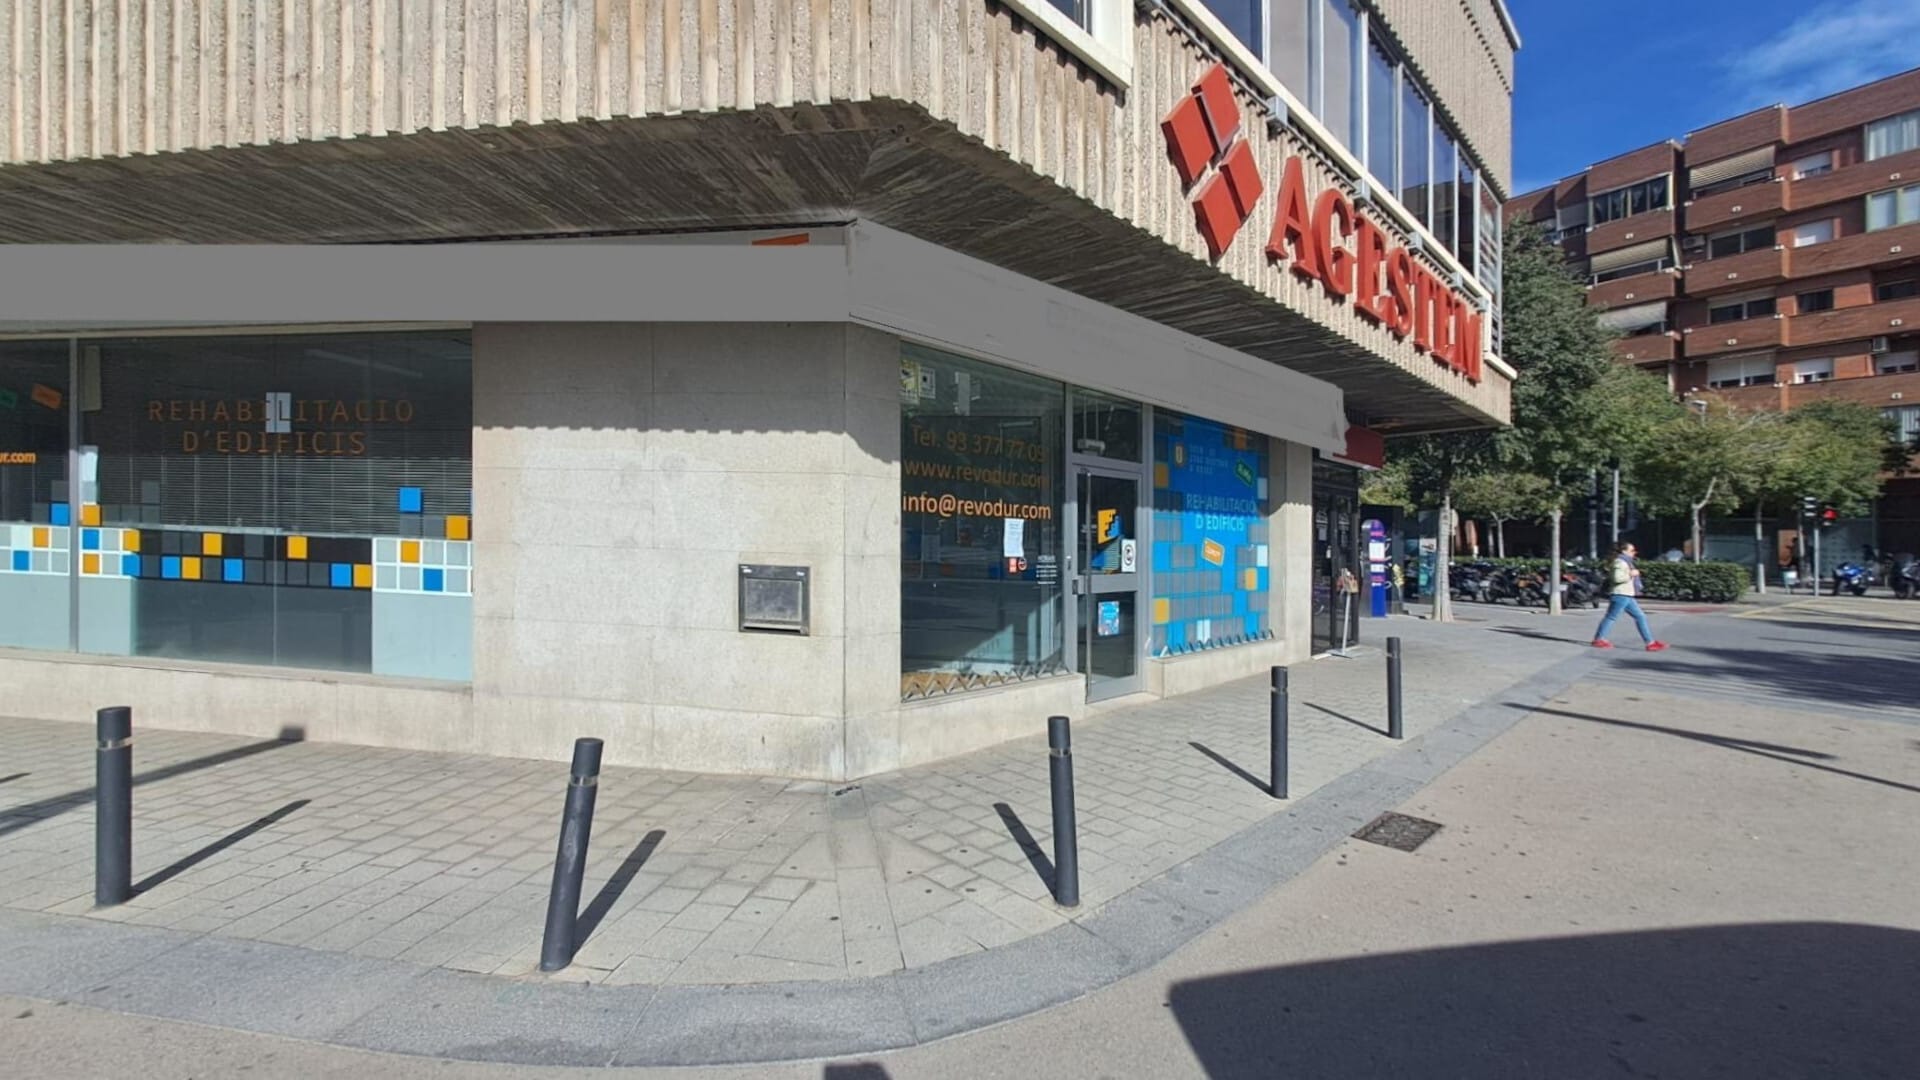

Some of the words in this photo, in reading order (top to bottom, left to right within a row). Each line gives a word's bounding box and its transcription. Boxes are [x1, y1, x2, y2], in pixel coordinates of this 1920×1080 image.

[1265, 155, 1482, 383] AGESTEM
[182, 431, 367, 454] D'EDIFICIS
[909, 424, 942, 449] Tel.
[946, 430, 968, 452] 93
[904, 459, 1050, 488] www.revodur.com
[902, 491, 1051, 520] info@revodur.com
